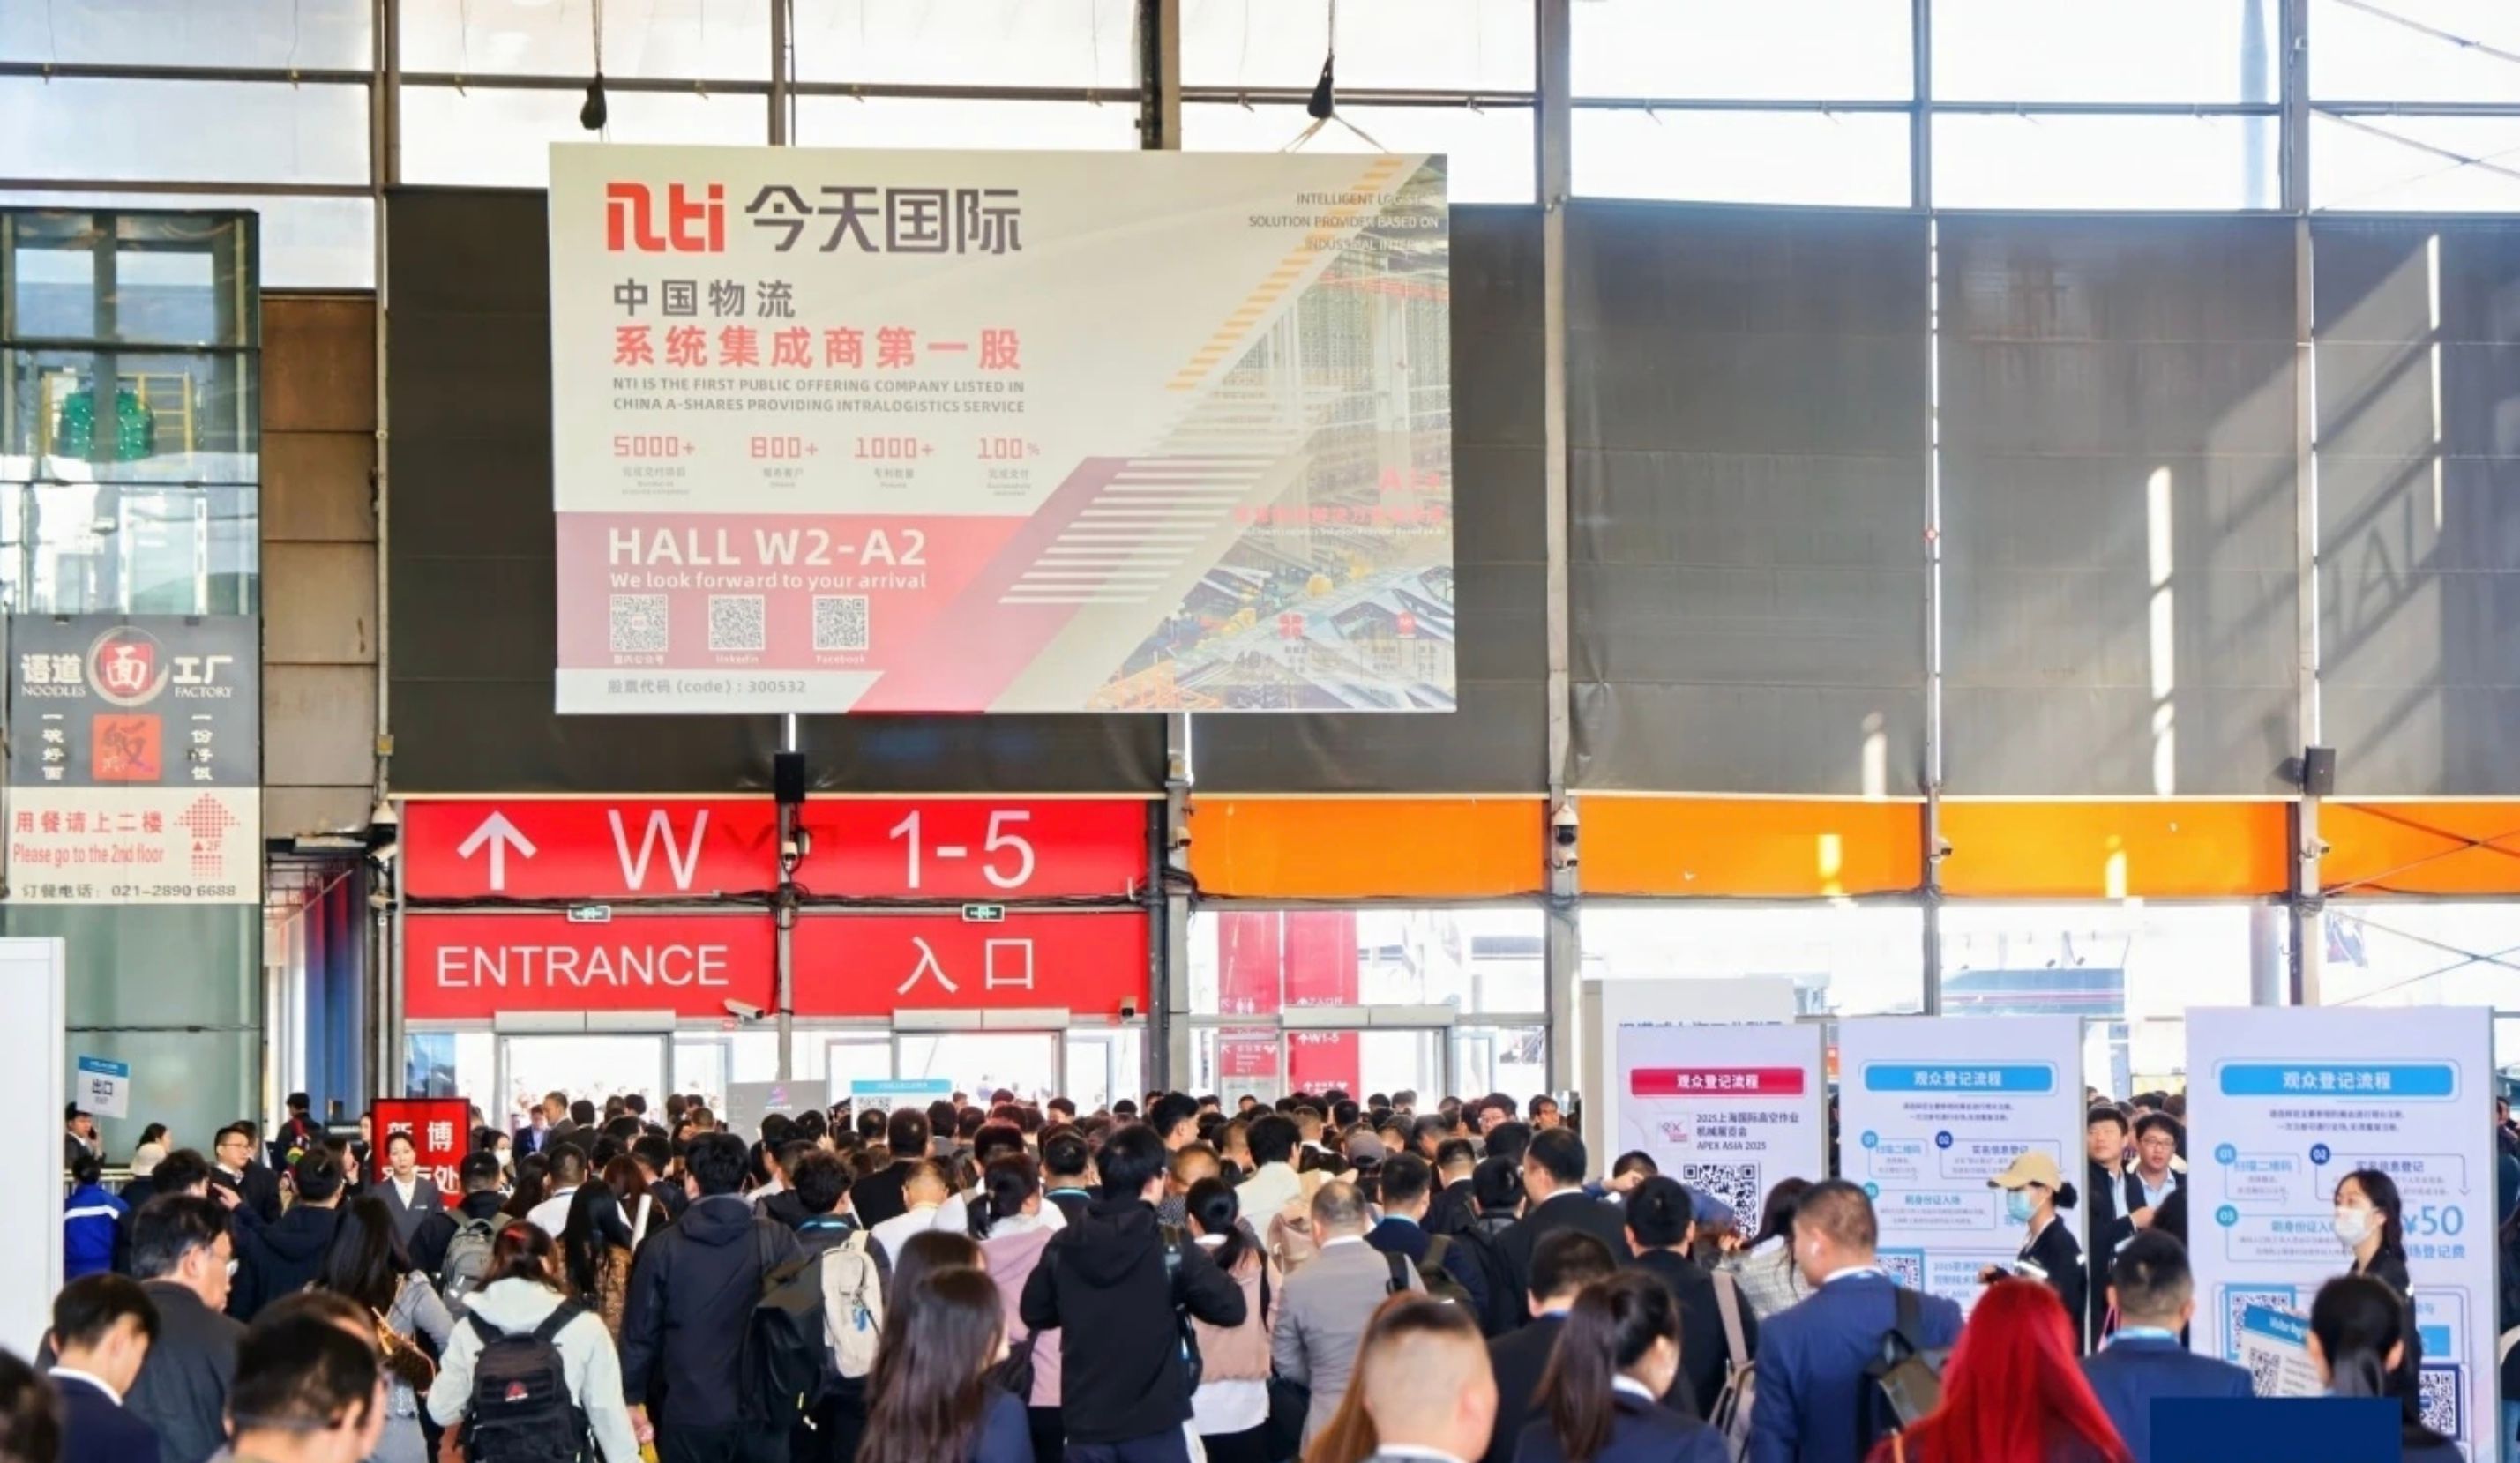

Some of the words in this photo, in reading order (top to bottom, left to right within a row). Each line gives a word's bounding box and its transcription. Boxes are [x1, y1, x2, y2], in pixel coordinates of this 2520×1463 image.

[1297, 193, 1374, 205] INTELLIGENT
[745, 185, 1022, 255] 今天国际
[1249, 216, 1310, 228] SOLUTION
[1378, 217, 1416, 228] BASED
[1420, 217, 1439, 228] ON
[613, 276, 796, 317] 中国物流
[613, 325, 1021, 370] 系统集成商第一股
[613, 377, 638, 390] NTI
[641, 378, 655, 391] IS
[659, 378, 689, 391] THE
[693, 378, 734, 392] FIRST
[739, 379, 791, 392] PUBLIC
[796, 379, 870, 392] OFFERING
[875, 380, 949, 392] COMPANY
[953, 380, 1004, 393] LISTED
[1008, 381, 1025, 393] IN
[613, 398, 662, 410] CHINA
[666, 398, 744, 411] A-SHARES
[747, 399, 834, 411] PROVIDING
[836, 399, 960, 412] INTRALOGISTICS
[964, 400, 1025, 413] SERVICE
[613, 435, 696, 458] 5000+
[751, 437, 819, 459] 800+
[854, 437, 935, 459] 1000+
[977, 437, 1040, 460] 100%
[608, 527, 742, 566] HALL
[754, 527, 927, 566] W2-A2
[610, 572, 641, 588] We
[647, 572, 691, 589] look
[695, 572, 779, 589] forward
[783, 574, 803, 589] to
[808, 576, 856, 593] your
[858, 573, 927, 590] arrival
[21, 654, 82, 684] 语道
[106, 645, 147, 690] 面
[173, 656, 233, 684] 工厂
[21, 685, 86, 698] NOODLES
[175, 687, 233, 698] FACTORY
[607, 679, 671, 694] 股票代码
[677, 680, 732, 695] (code)
[748, 680, 806, 694] 300532
[15, 811, 162, 833] 用餐请上二楼
[13, 844, 51, 863] Please
[55, 849, 69, 868] go
[73, 847, 85, 863] to
[89, 844, 107, 863] the
[111, 844, 132, 863] 2nd
[137, 844, 164, 863] floor
[207, 841, 221, 851] 2F
[608, 809, 709, 890] W
[889, 810, 1036, 889] 1-5
[197, 885, 236, 897] 6688
[437, 945, 729, 987] ENTRANCE
[897, 937, 1035, 995] 入口
[1677, 1074, 1759, 1089] 观众登记流程
[1914, 1071, 2002, 1086] 观众登记流程
[2283, 1071, 2391, 1090] 观众登记流程
[1696, 1125, 1747, 1138] 机械展览会
[1697, 1141, 1719, 1150] APEX
[1722, 1141, 1743, 1150] ASIA
[1746, 1141, 1766, 1150] 2025
